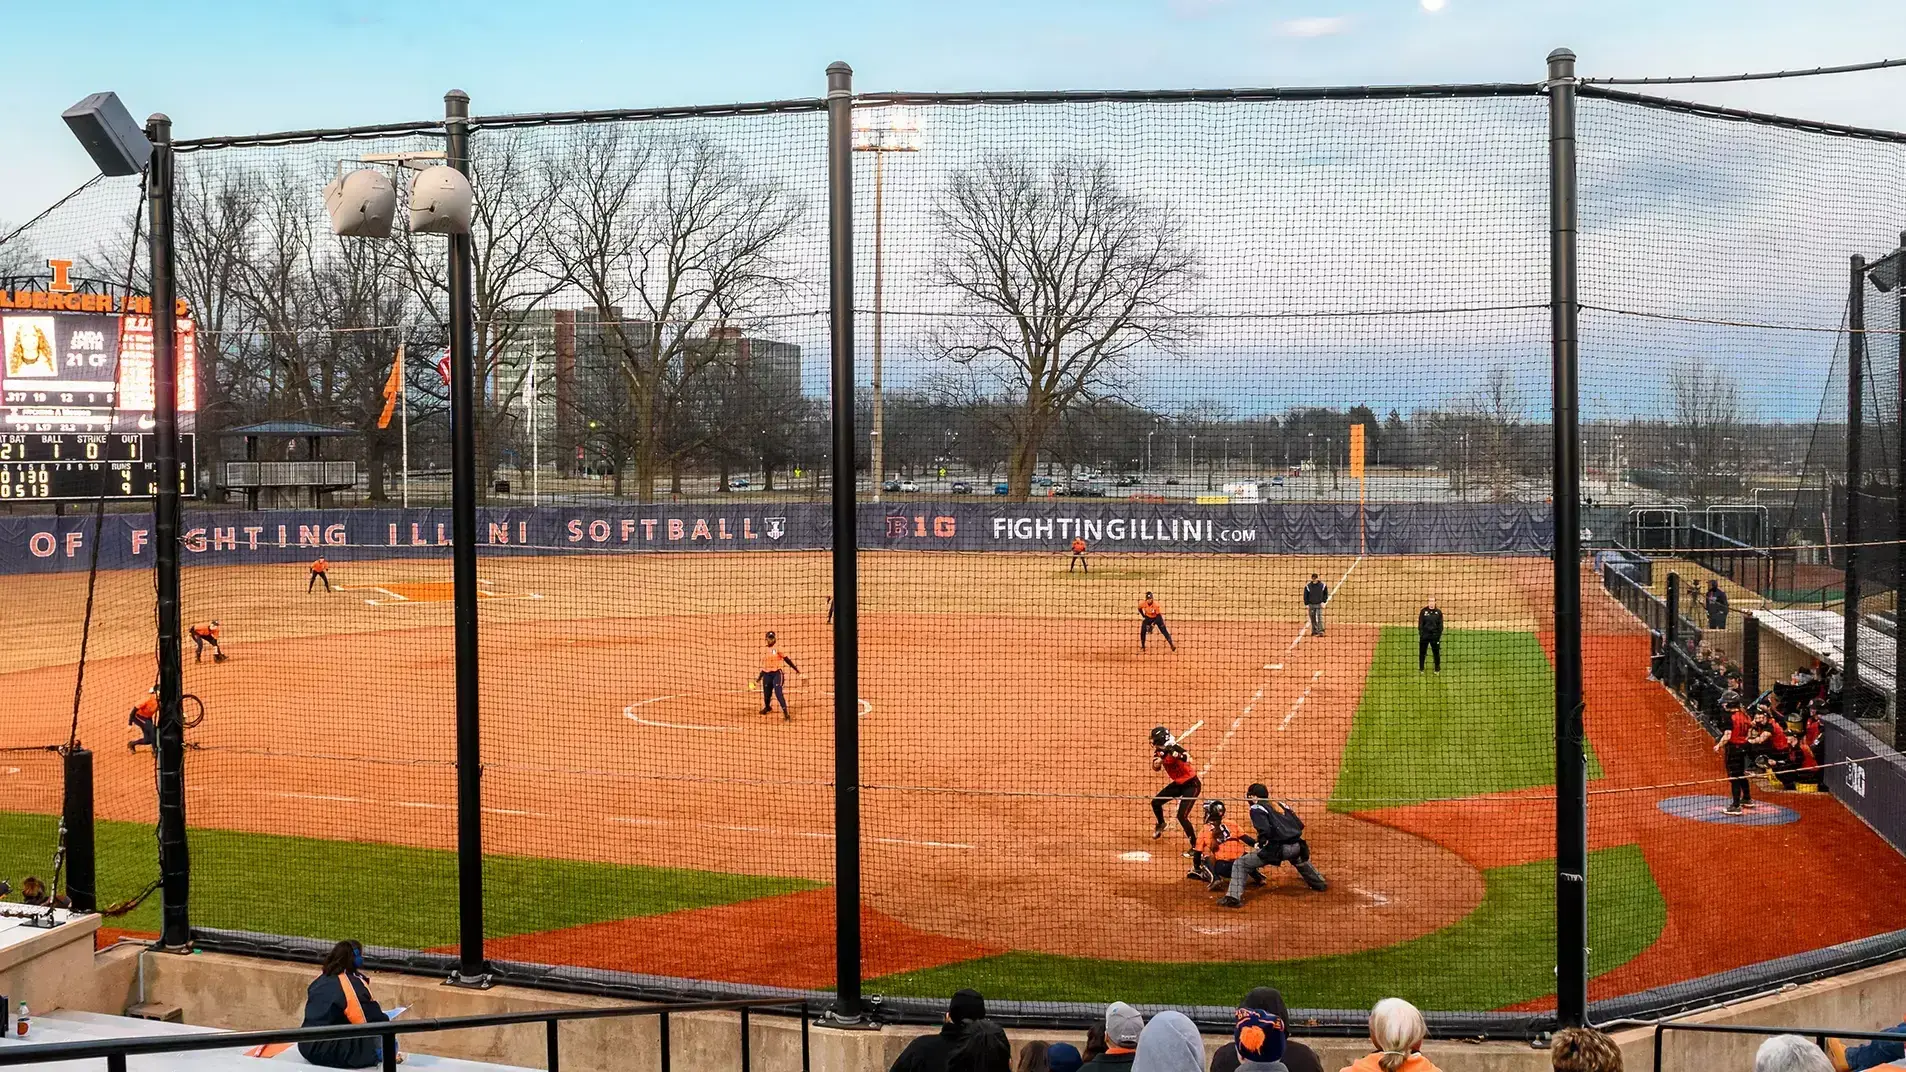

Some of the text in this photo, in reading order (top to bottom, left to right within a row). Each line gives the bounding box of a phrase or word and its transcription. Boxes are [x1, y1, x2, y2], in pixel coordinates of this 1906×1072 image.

[49, 259, 74, 292] I
[66, 353, 107, 367] 21 CF
[9, 435, 26, 443] BAT
[41, 435, 63, 443] BALL
[77, 435, 107, 443] STRIKE
[121, 435, 139, 443] OUT
[54, 444, 59, 458] 1
[86, 443, 98, 459] 0
[130, 443, 136, 458] 1
[121, 470, 131, 481] 4
[15, 484, 25, 497] 5
[40, 484, 49, 497] 3
[121, 482, 131, 494] 9
[29, 518, 759, 558] OF FGHTING ILLNI SOFTBALL
